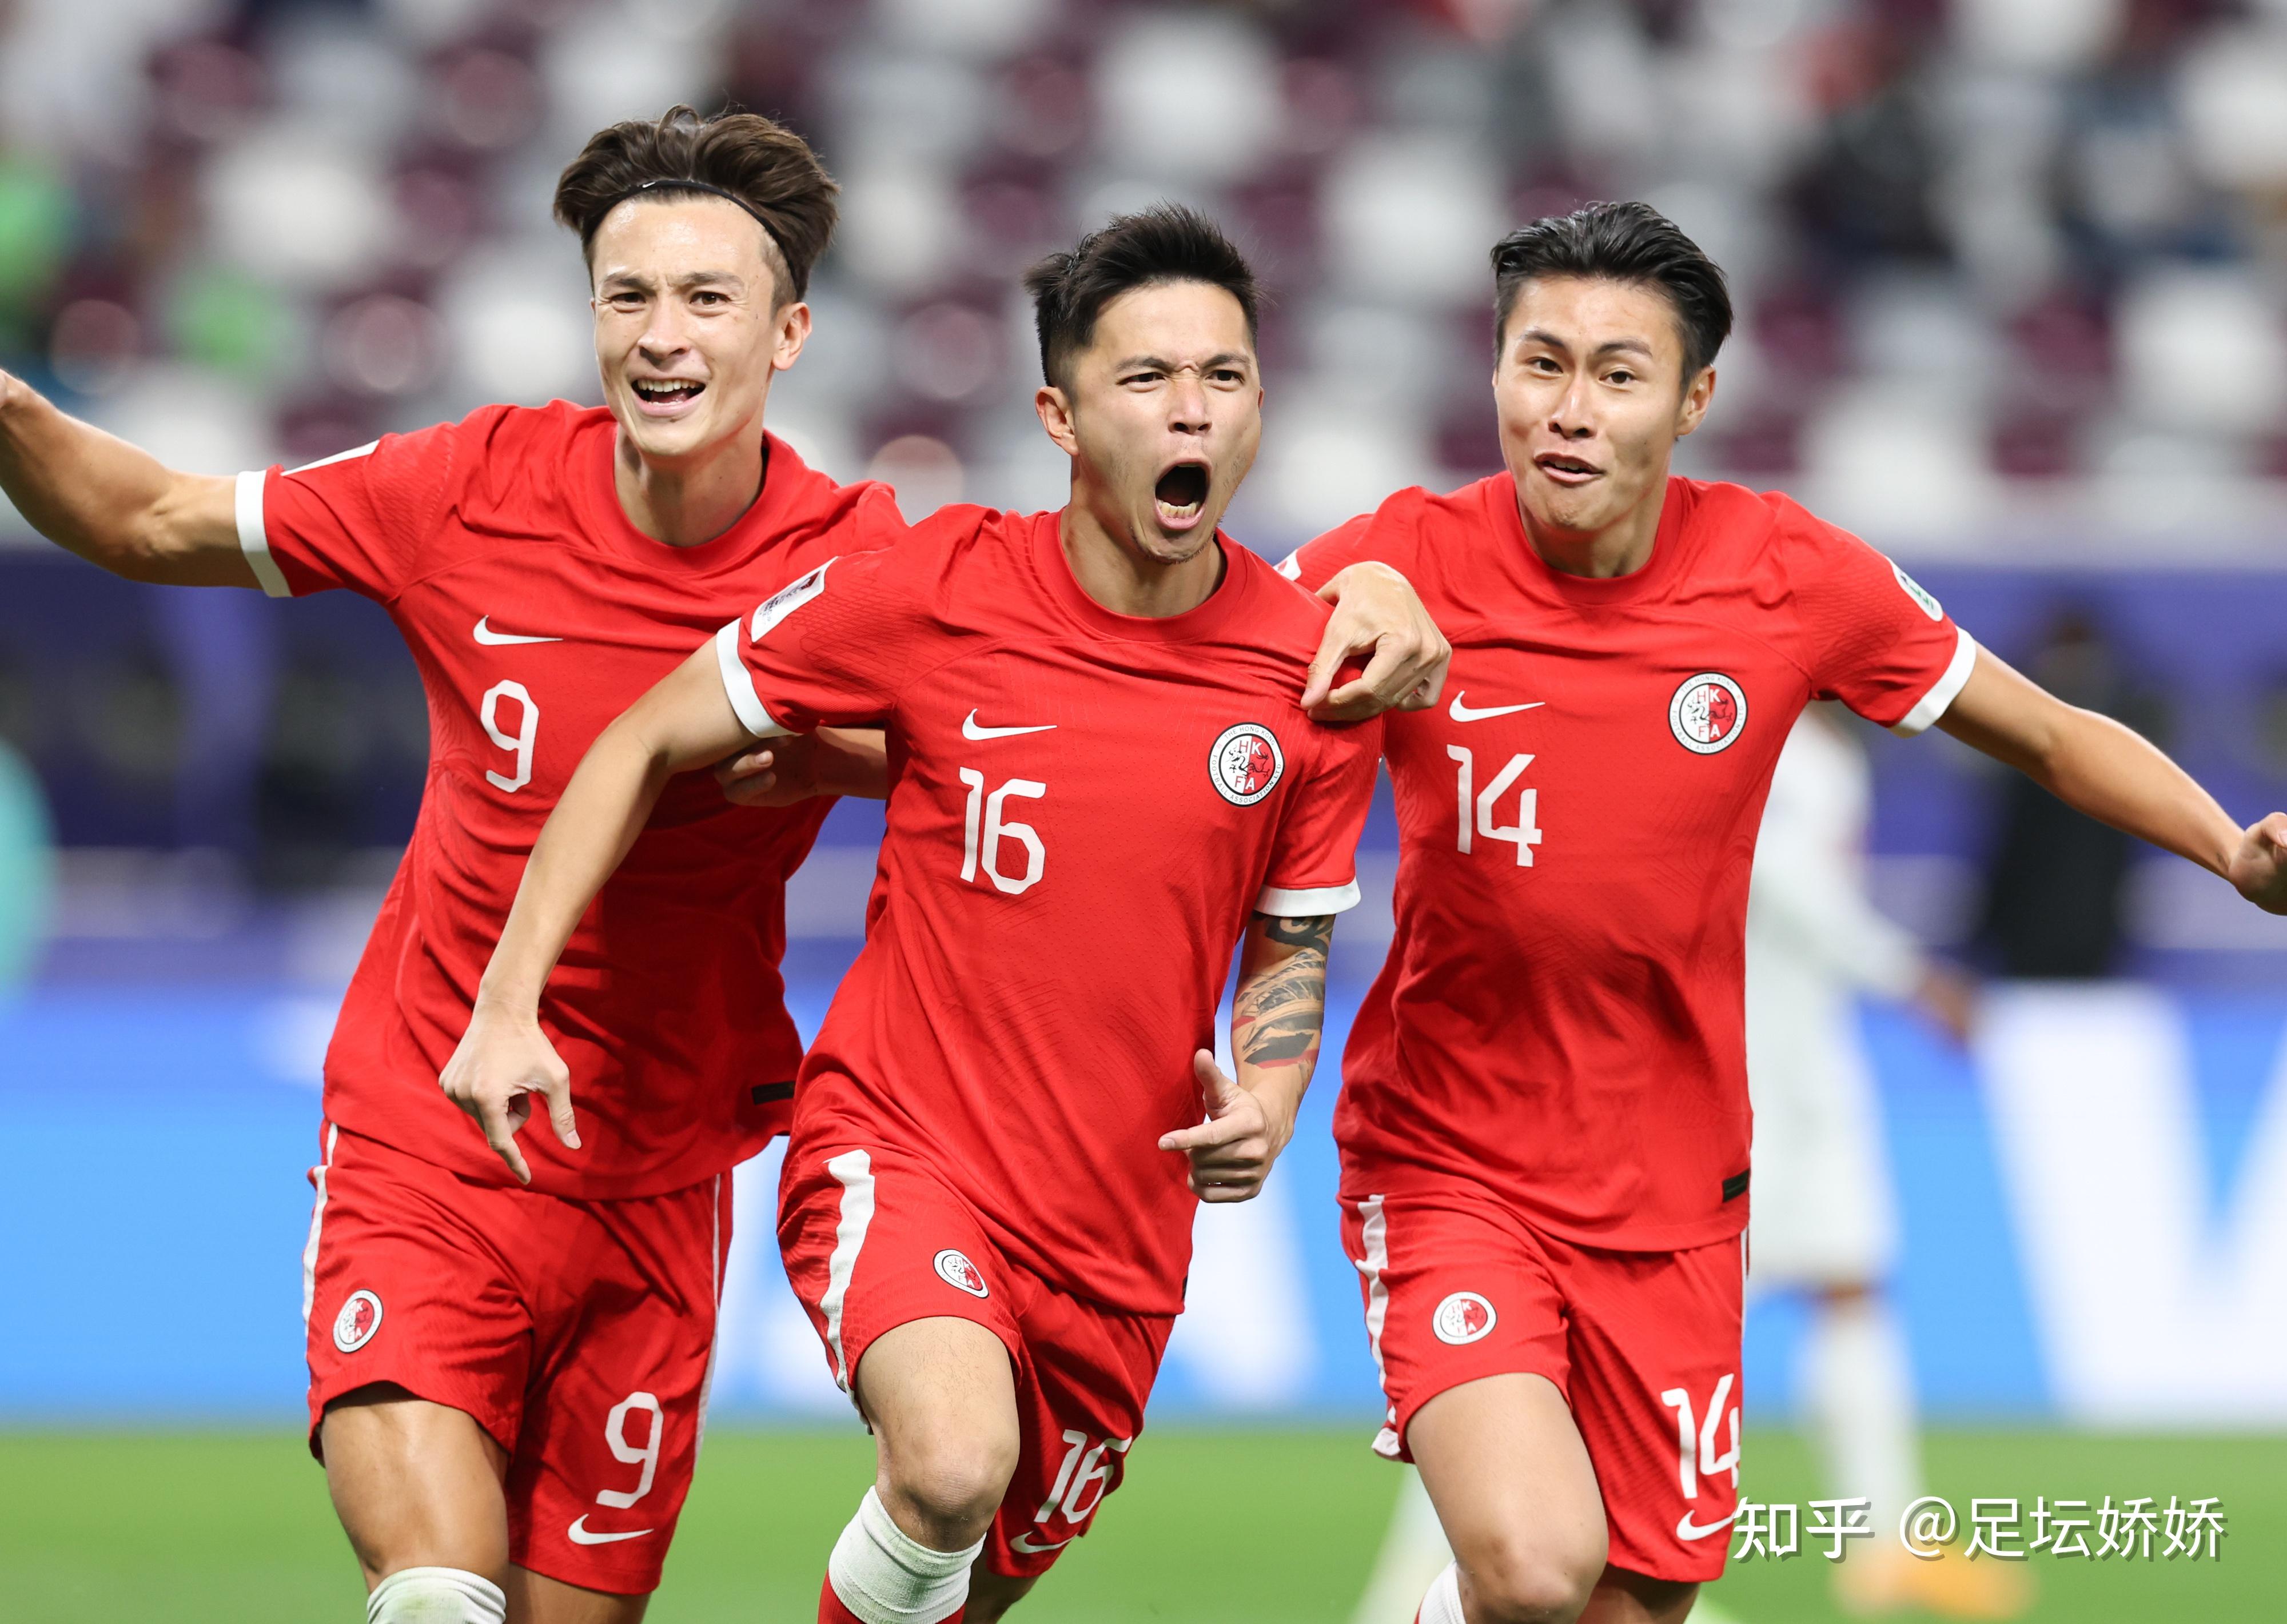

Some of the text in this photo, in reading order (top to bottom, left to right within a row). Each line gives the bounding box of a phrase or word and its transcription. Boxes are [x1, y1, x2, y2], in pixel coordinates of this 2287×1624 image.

[1682, 682, 1693, 693] THE
[1717, 677, 1734, 690] KONG
[1696, 688, 1721, 703] HK
[481, 680, 539, 792] 9
[1224, 729, 1237, 740] THE
[1261, 729, 1276, 746] KONG
[1238, 740, 1263, 756] HK
[1672, 710, 1692, 748] FOOTBALL
[1695, 724, 1740, 751] ASSOCIATION
[1698, 723, 1721, 738] FA
[1212, 755, 1228, 796] FOOTBALL
[1229, 781, 1274, 803] ASSOCIATION
[1234, 775, 1255, 791] FA
[1448, 745, 1541, 867] 14
[960, 767, 1046, 895] 16
[596, 1391, 663, 1509] 9
[1660, 1373, 1741, 1499] 14
[1034, 1429, 1132, 1524] 16
